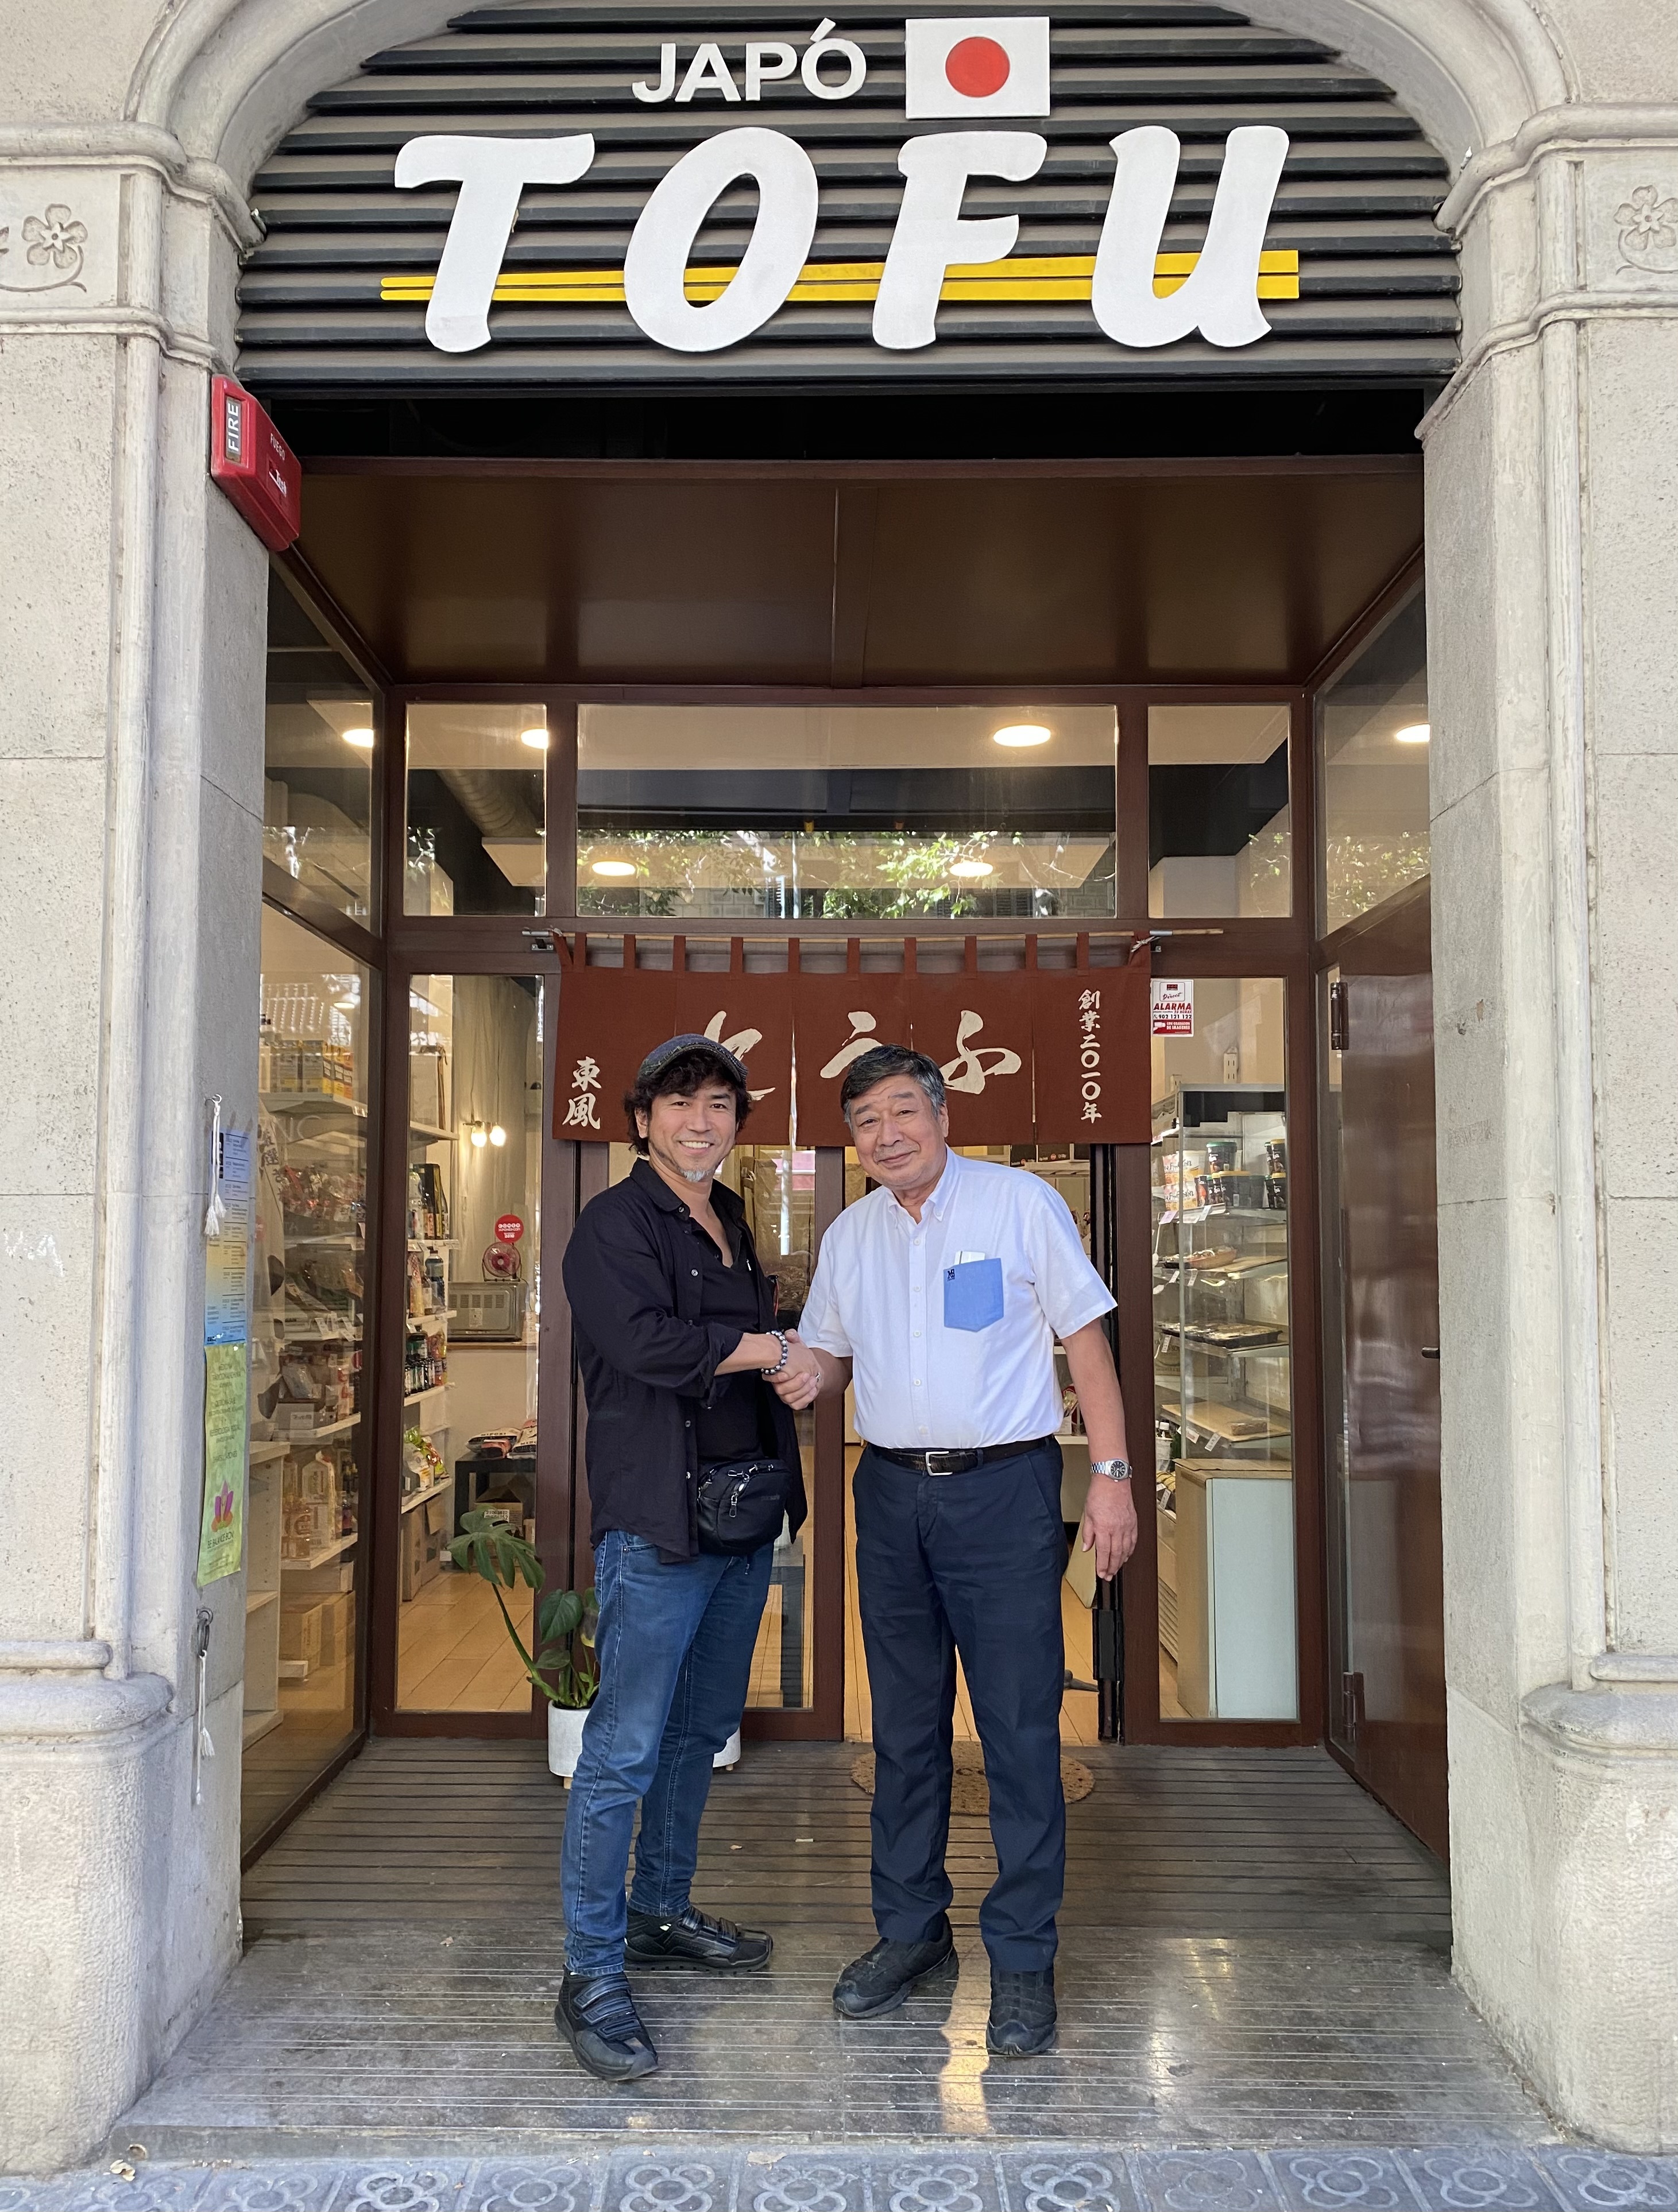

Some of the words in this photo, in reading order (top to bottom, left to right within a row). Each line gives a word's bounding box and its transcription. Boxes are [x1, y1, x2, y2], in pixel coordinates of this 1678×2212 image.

[632, 18, 867, 103] JAPÓ
[395, 125, 1290, 352] TOFU
[228, 402, 239, 452] FIRE
[270, 433, 285, 462] FUEGO
[1154, 1002, 1192, 1010] ALARMA
[562, 1056, 602, 1130] 東風
[1078, 989, 1102, 1124] 創業二〇一〇年
